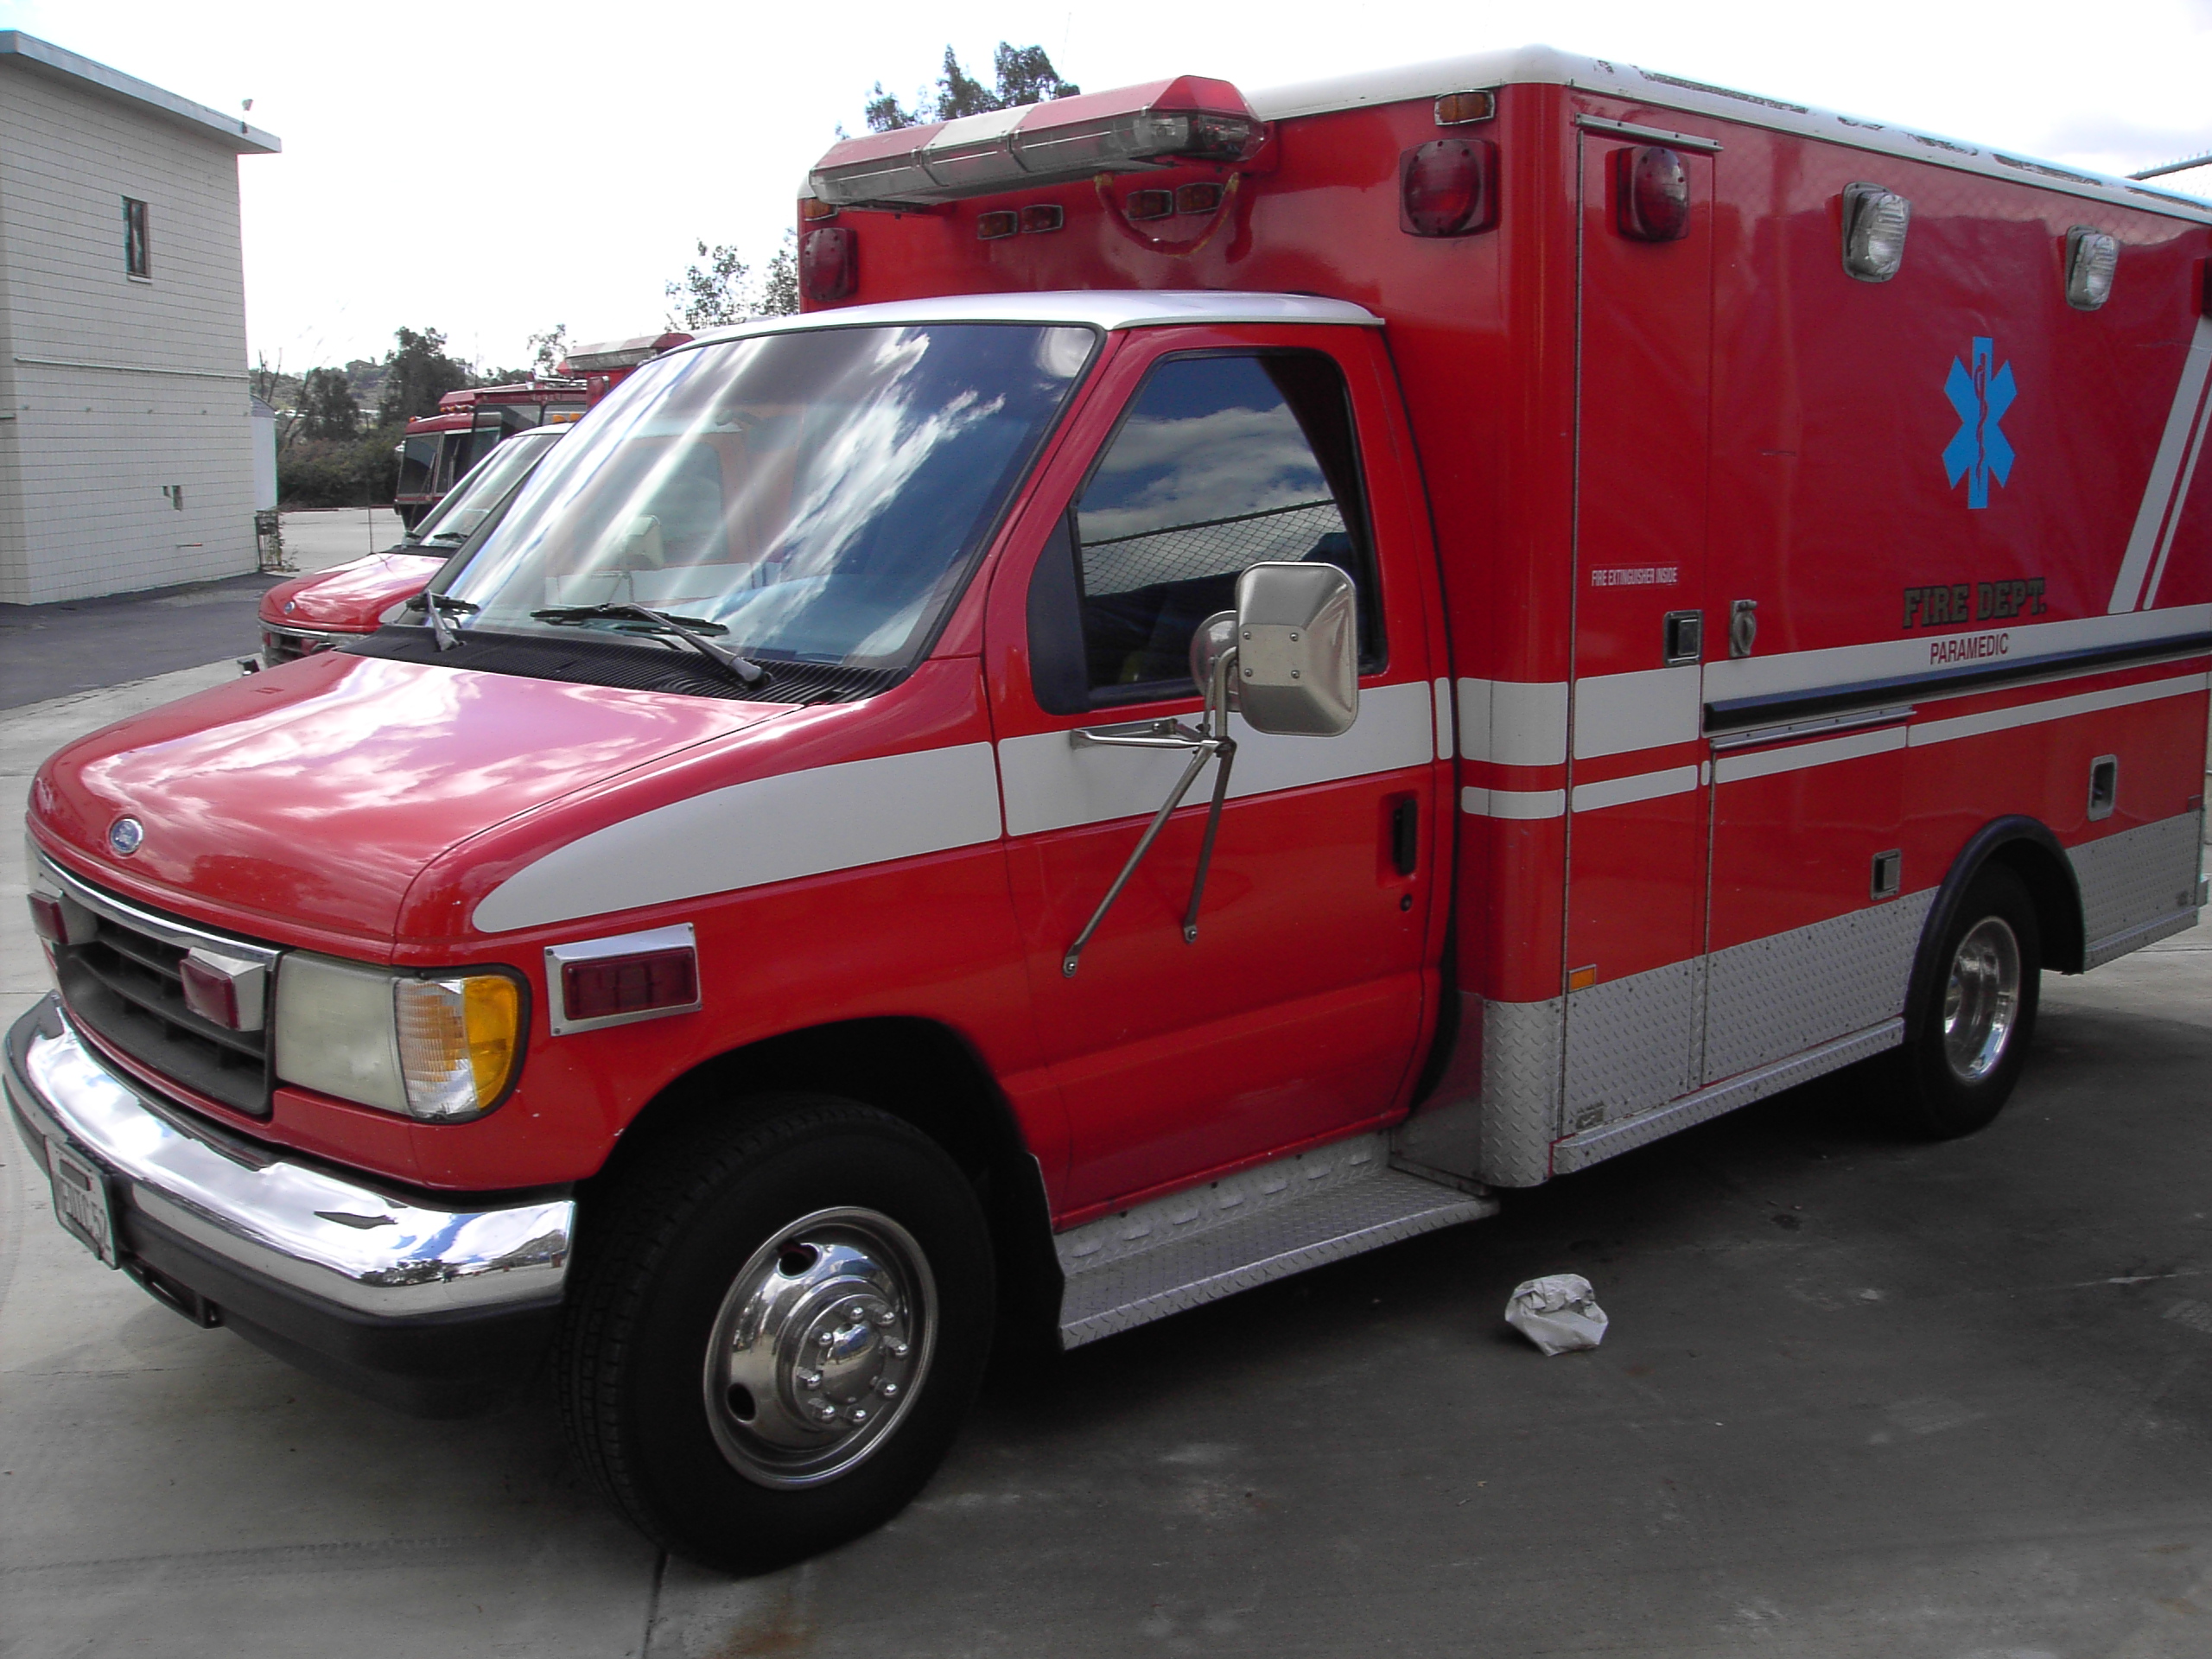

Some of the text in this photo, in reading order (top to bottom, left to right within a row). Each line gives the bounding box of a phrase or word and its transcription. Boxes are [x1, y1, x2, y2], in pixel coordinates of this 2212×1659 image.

[1592, 567, 1678, 587] FIRE EXTINGUISHER INSIDE
[1903, 576, 2048, 629] FIRE DEPT.
[1929, 632, 2010, 665] PARAMEDIC
